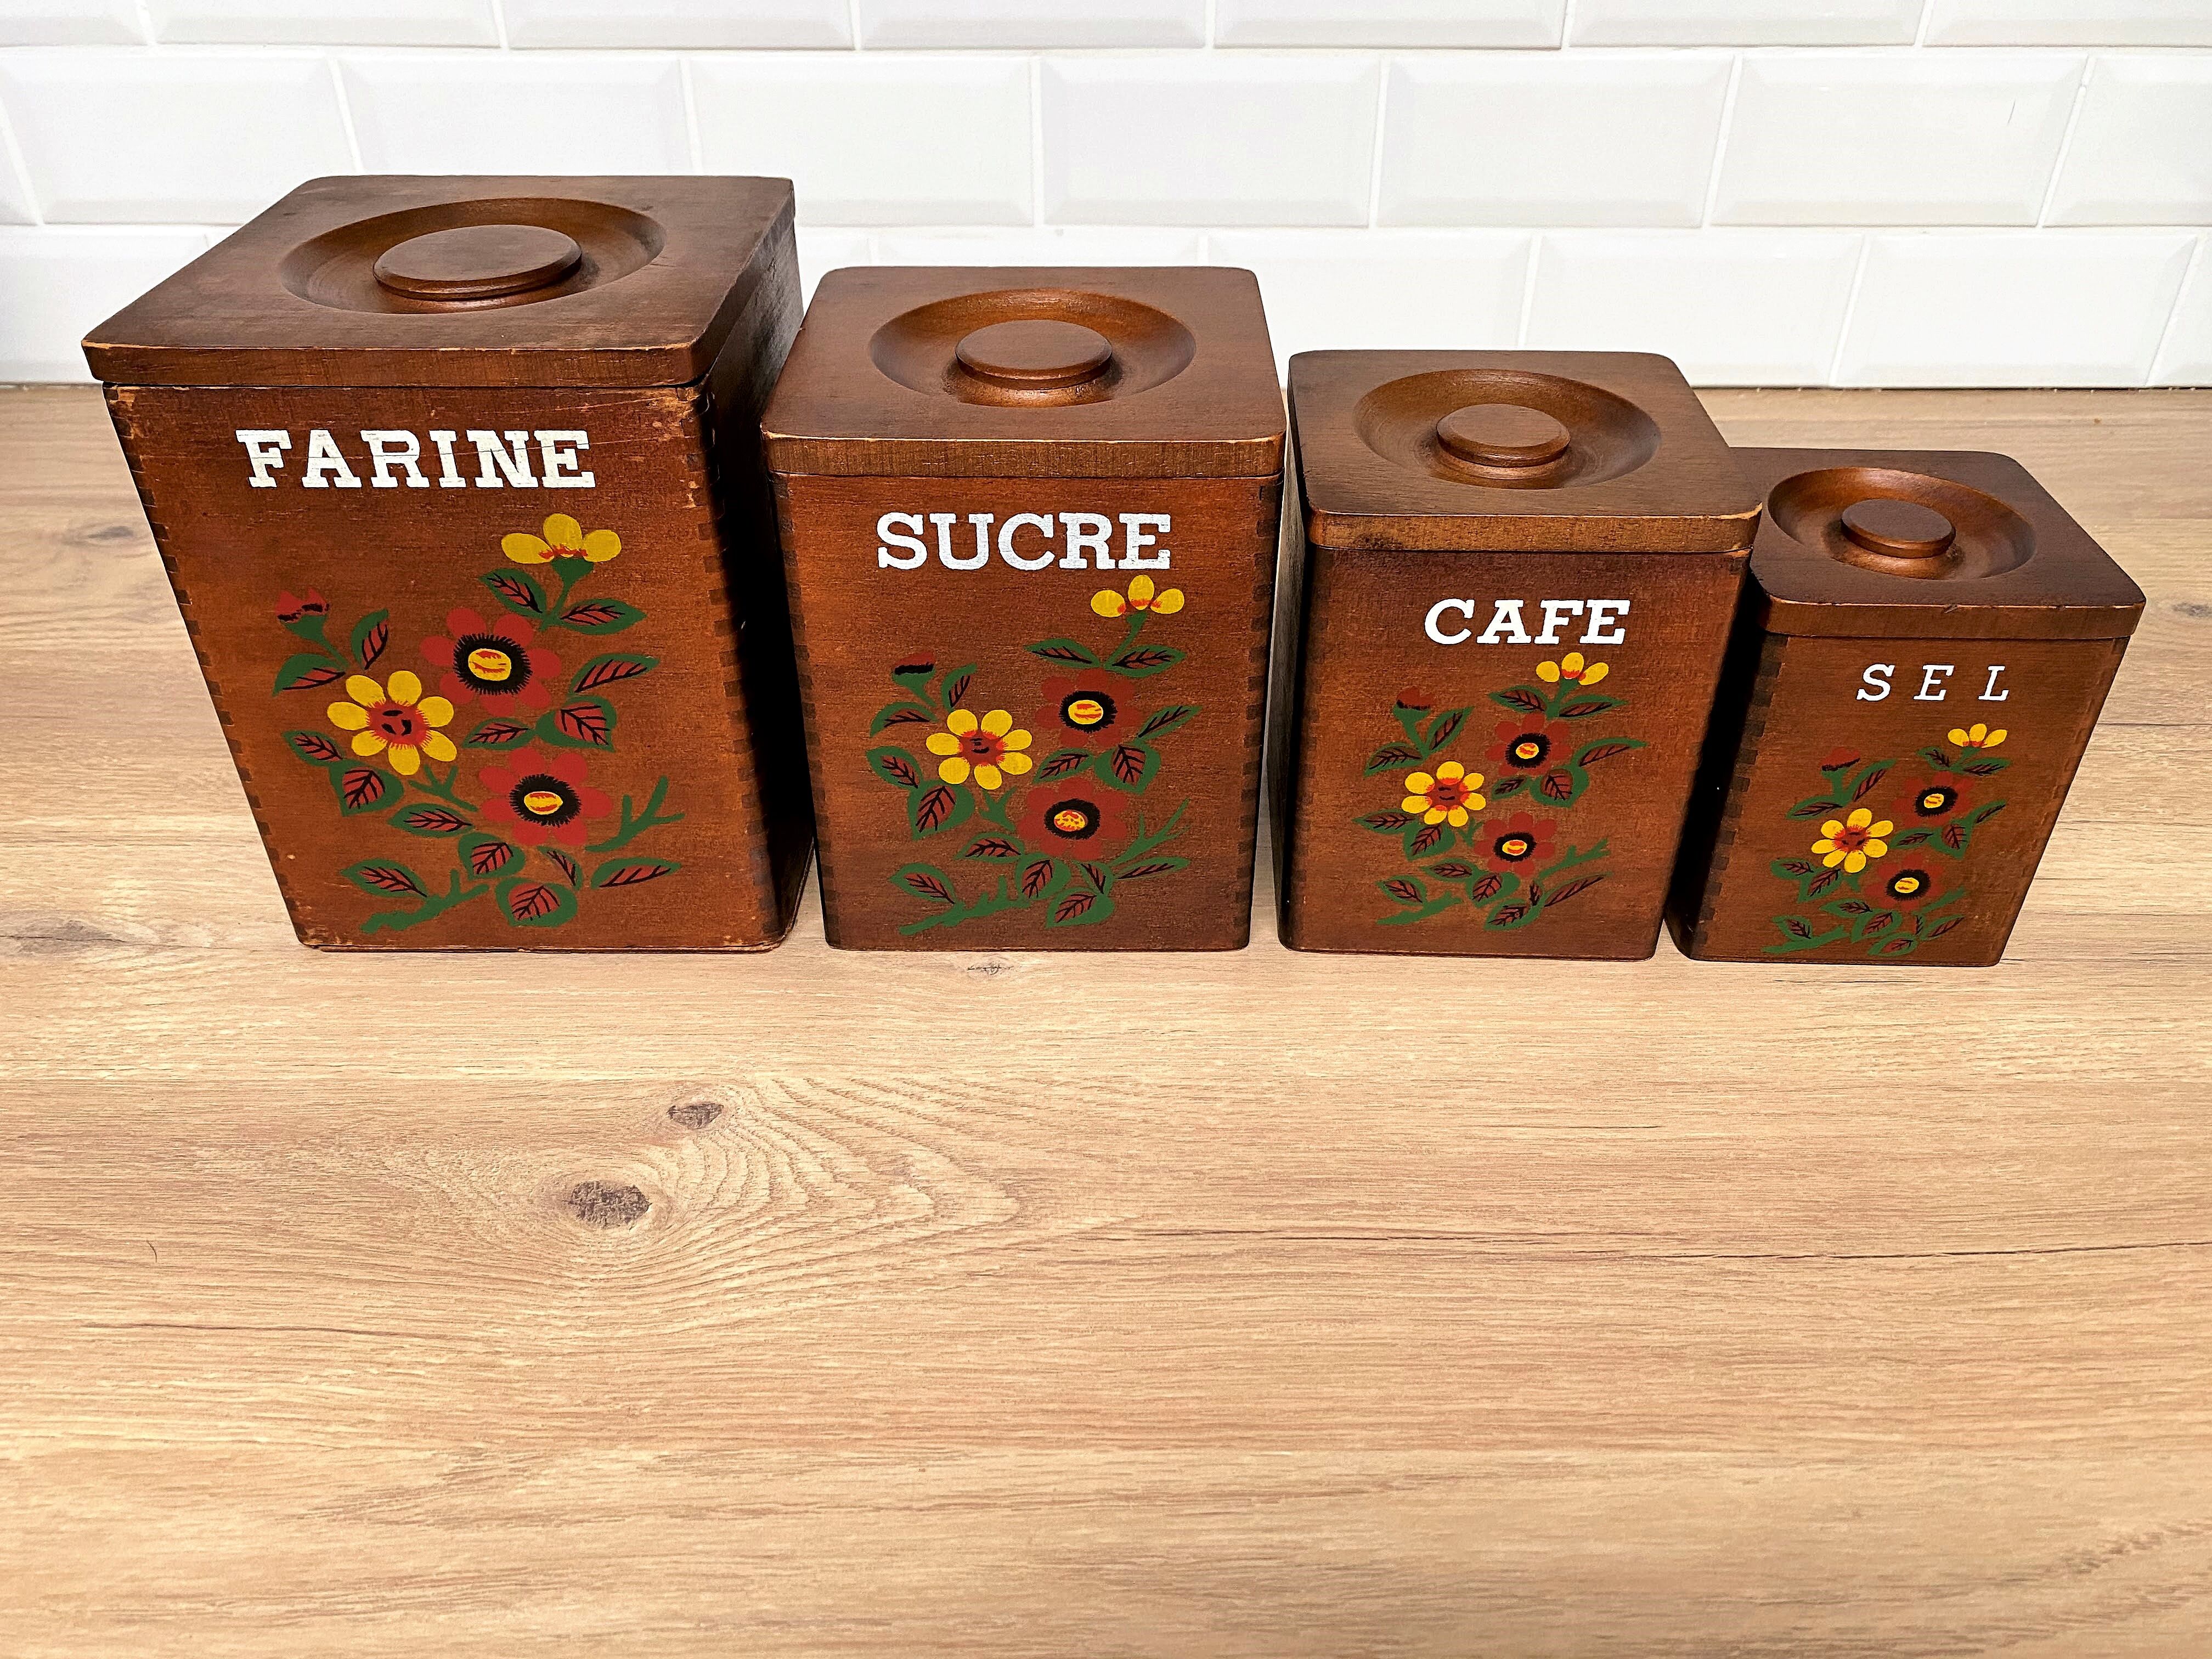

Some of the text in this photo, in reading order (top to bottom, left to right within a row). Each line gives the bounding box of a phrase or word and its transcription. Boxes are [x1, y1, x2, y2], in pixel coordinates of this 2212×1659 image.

[236, 430, 595, 488] FARINE
[877, 512, 1170, 571] SUCRE
[1425, 599, 1630, 644] CAFE
